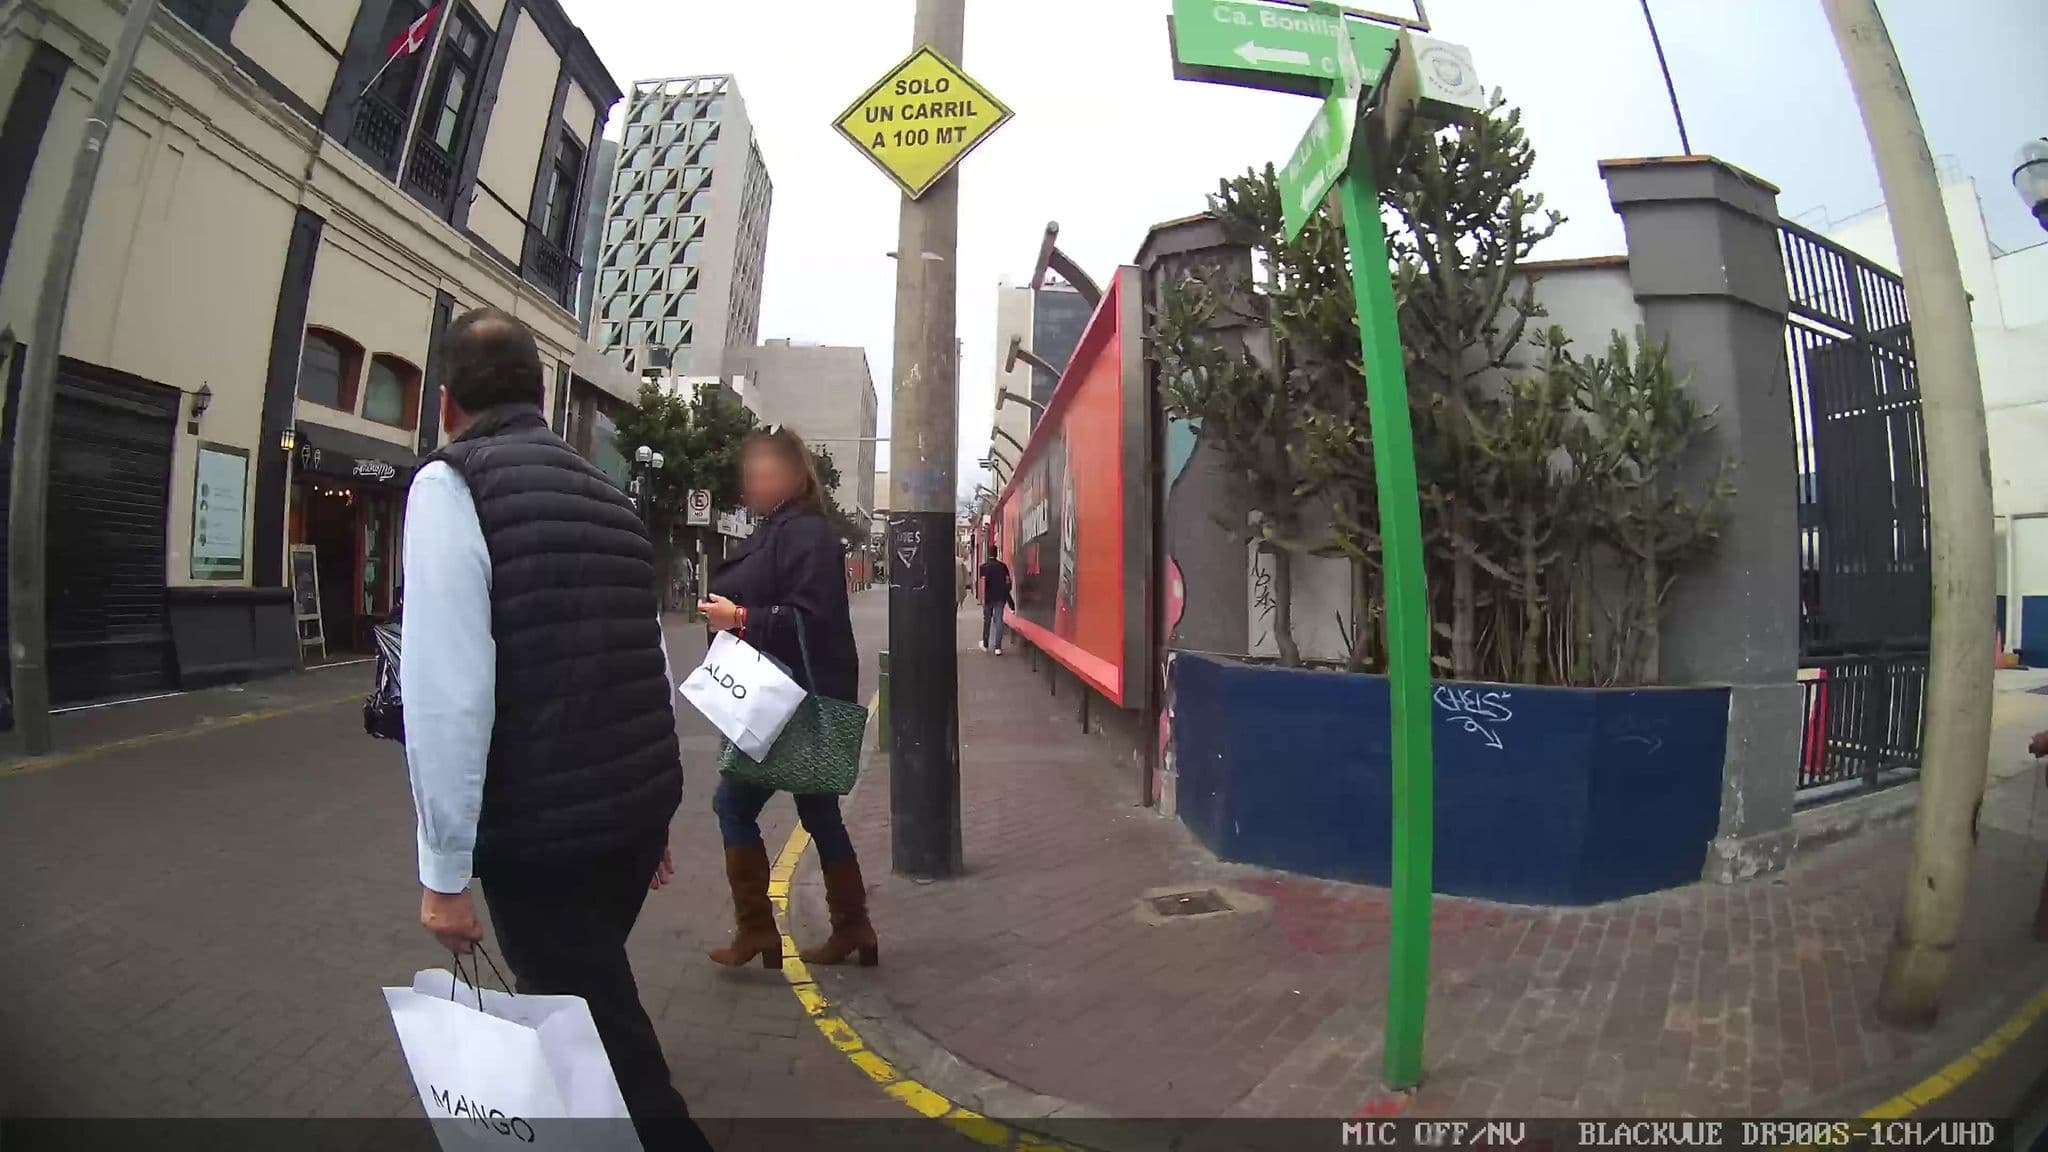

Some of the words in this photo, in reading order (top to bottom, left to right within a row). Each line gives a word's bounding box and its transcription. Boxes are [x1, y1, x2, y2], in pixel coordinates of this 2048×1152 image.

[1213, 5, 1253, 26] Ca.
[1259, 9, 1341, 38] Bonilla
[895, 78, 950, 95] SOLO
[866, 105, 894, 123] UN
[901, 100, 978, 120] CARRIL
[872, 132, 886, 149] A
[893, 129, 929, 147] 100
[936, 126, 967, 144] MT
[703, 663, 747, 699] ALDO
[430, 1084, 535, 1143] MANGO
